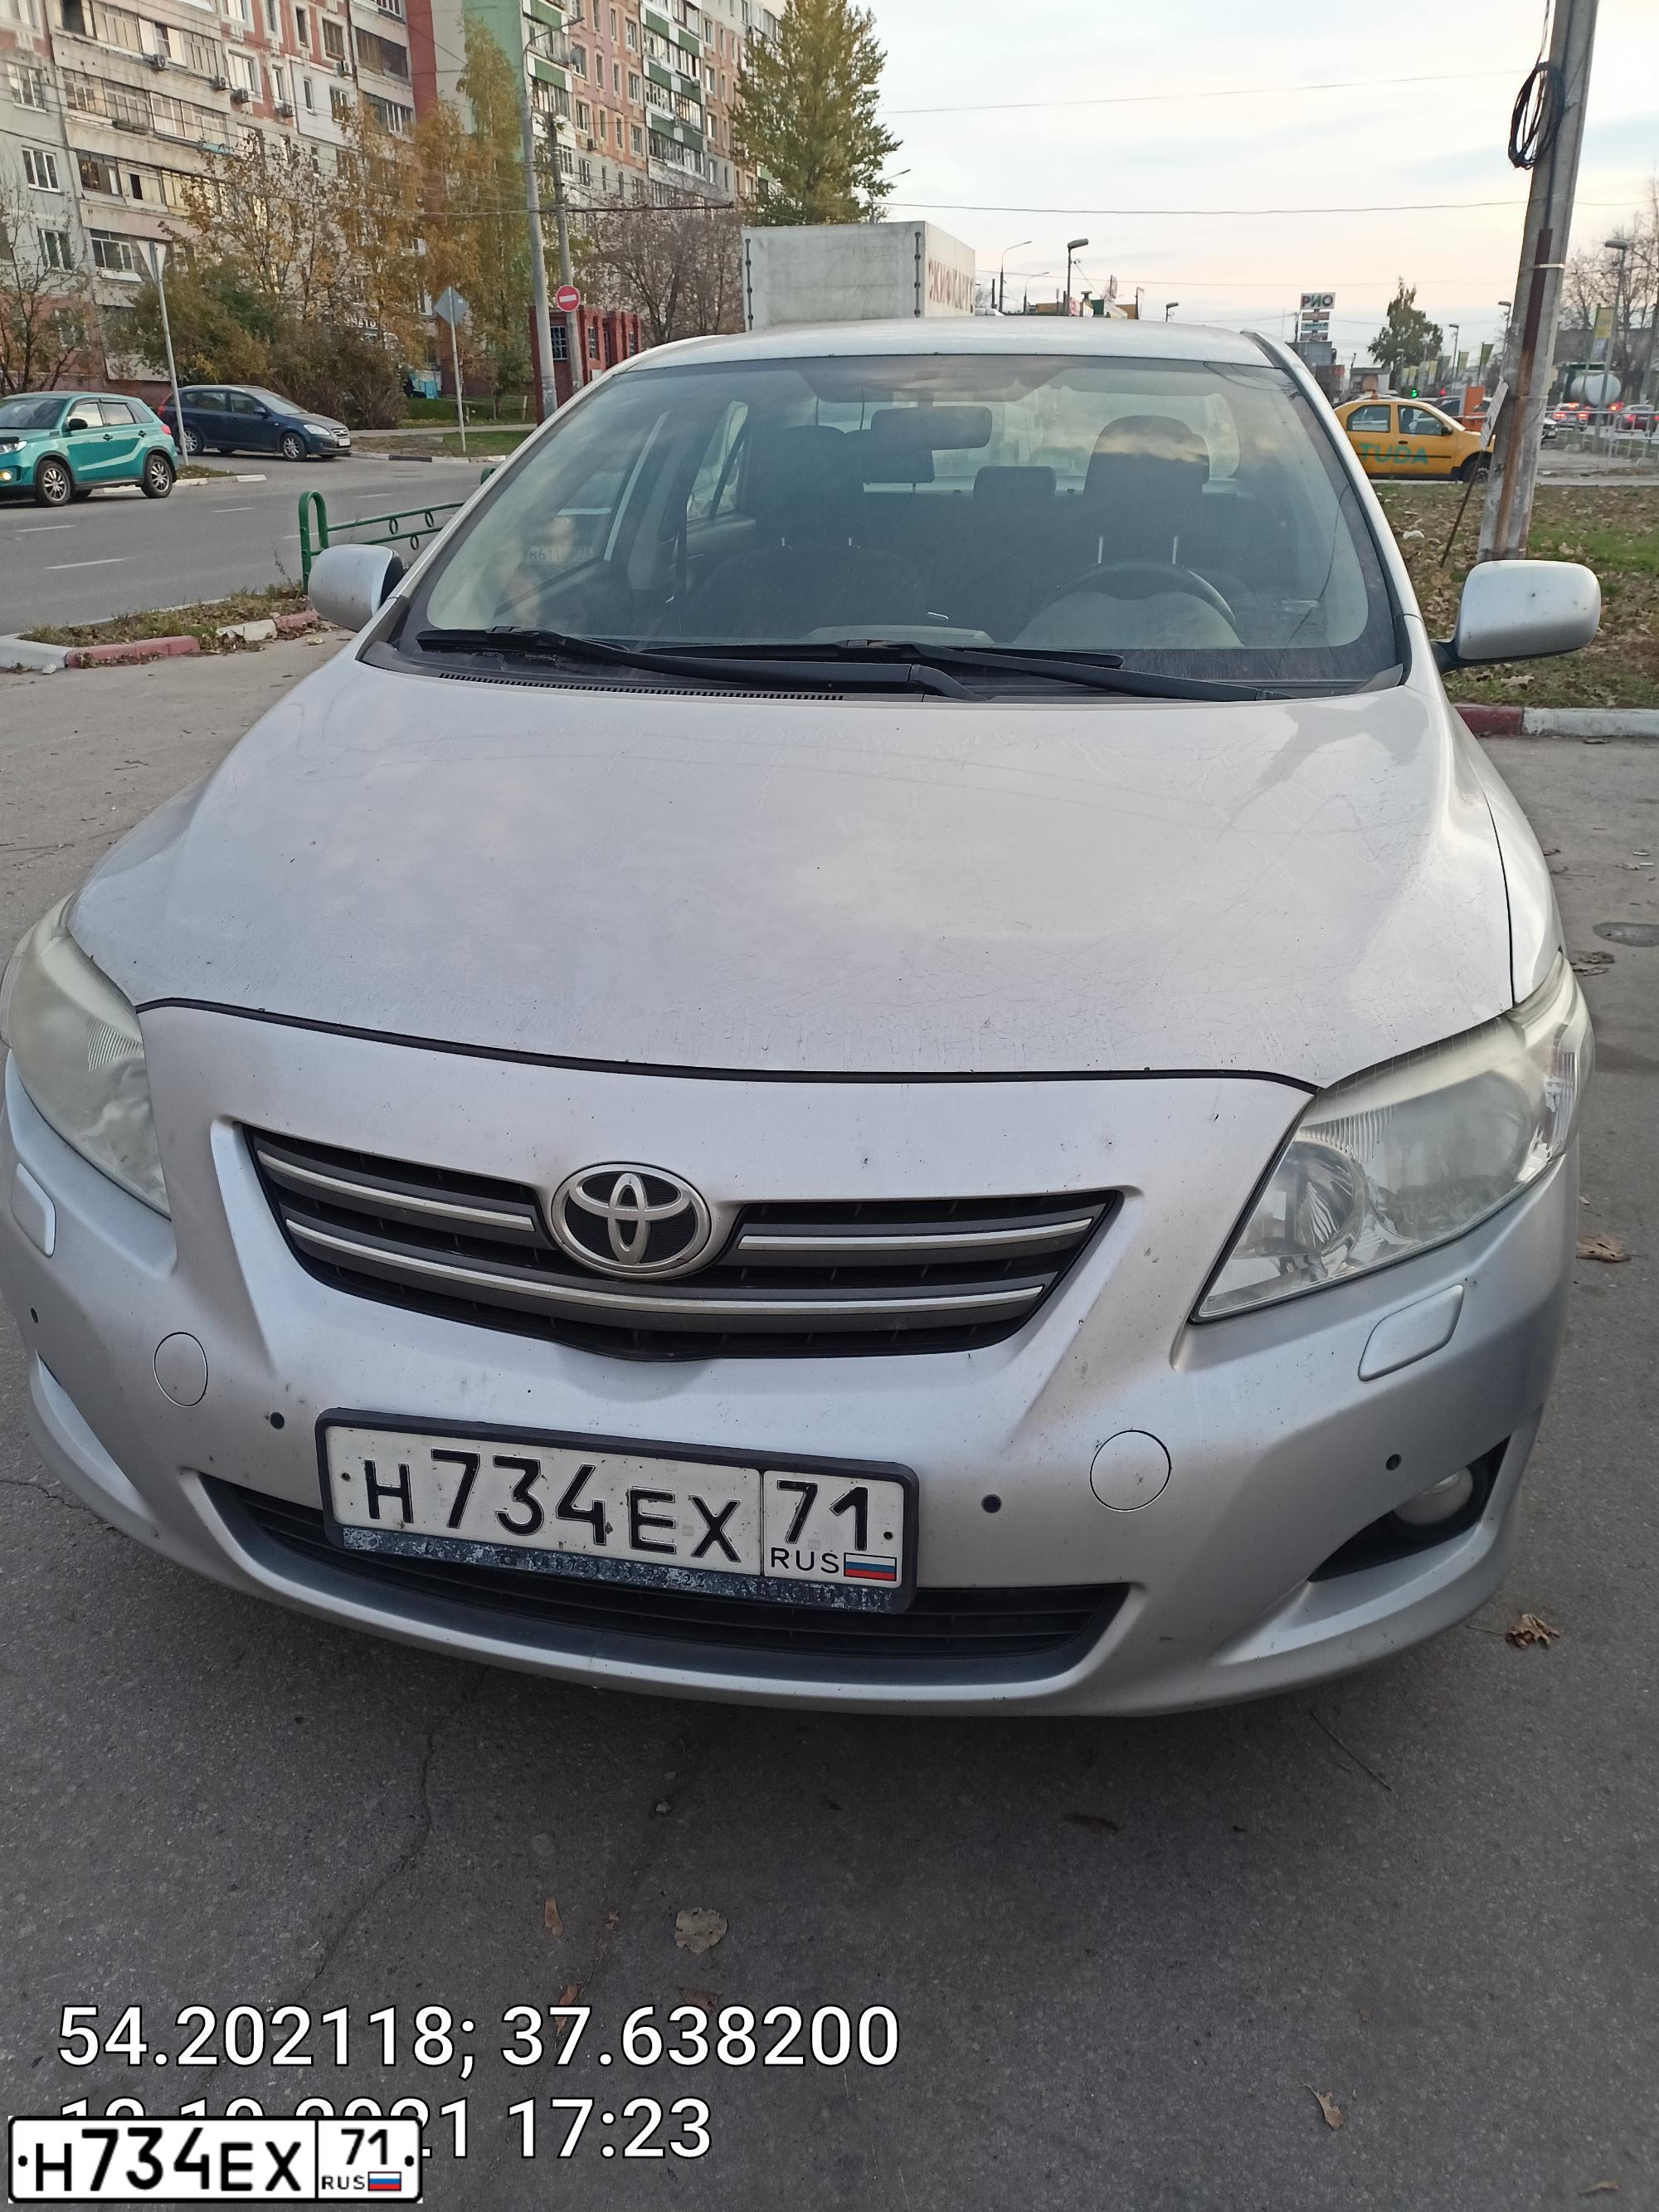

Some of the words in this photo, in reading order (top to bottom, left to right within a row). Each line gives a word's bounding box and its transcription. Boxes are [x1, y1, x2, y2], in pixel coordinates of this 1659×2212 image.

[1301, 295, 1334, 308] РИО
[1357, 441, 1429, 465] TUDA
[776, 1479, 868, 1551] 71
[770, 1547, 840, 1574] RUS
